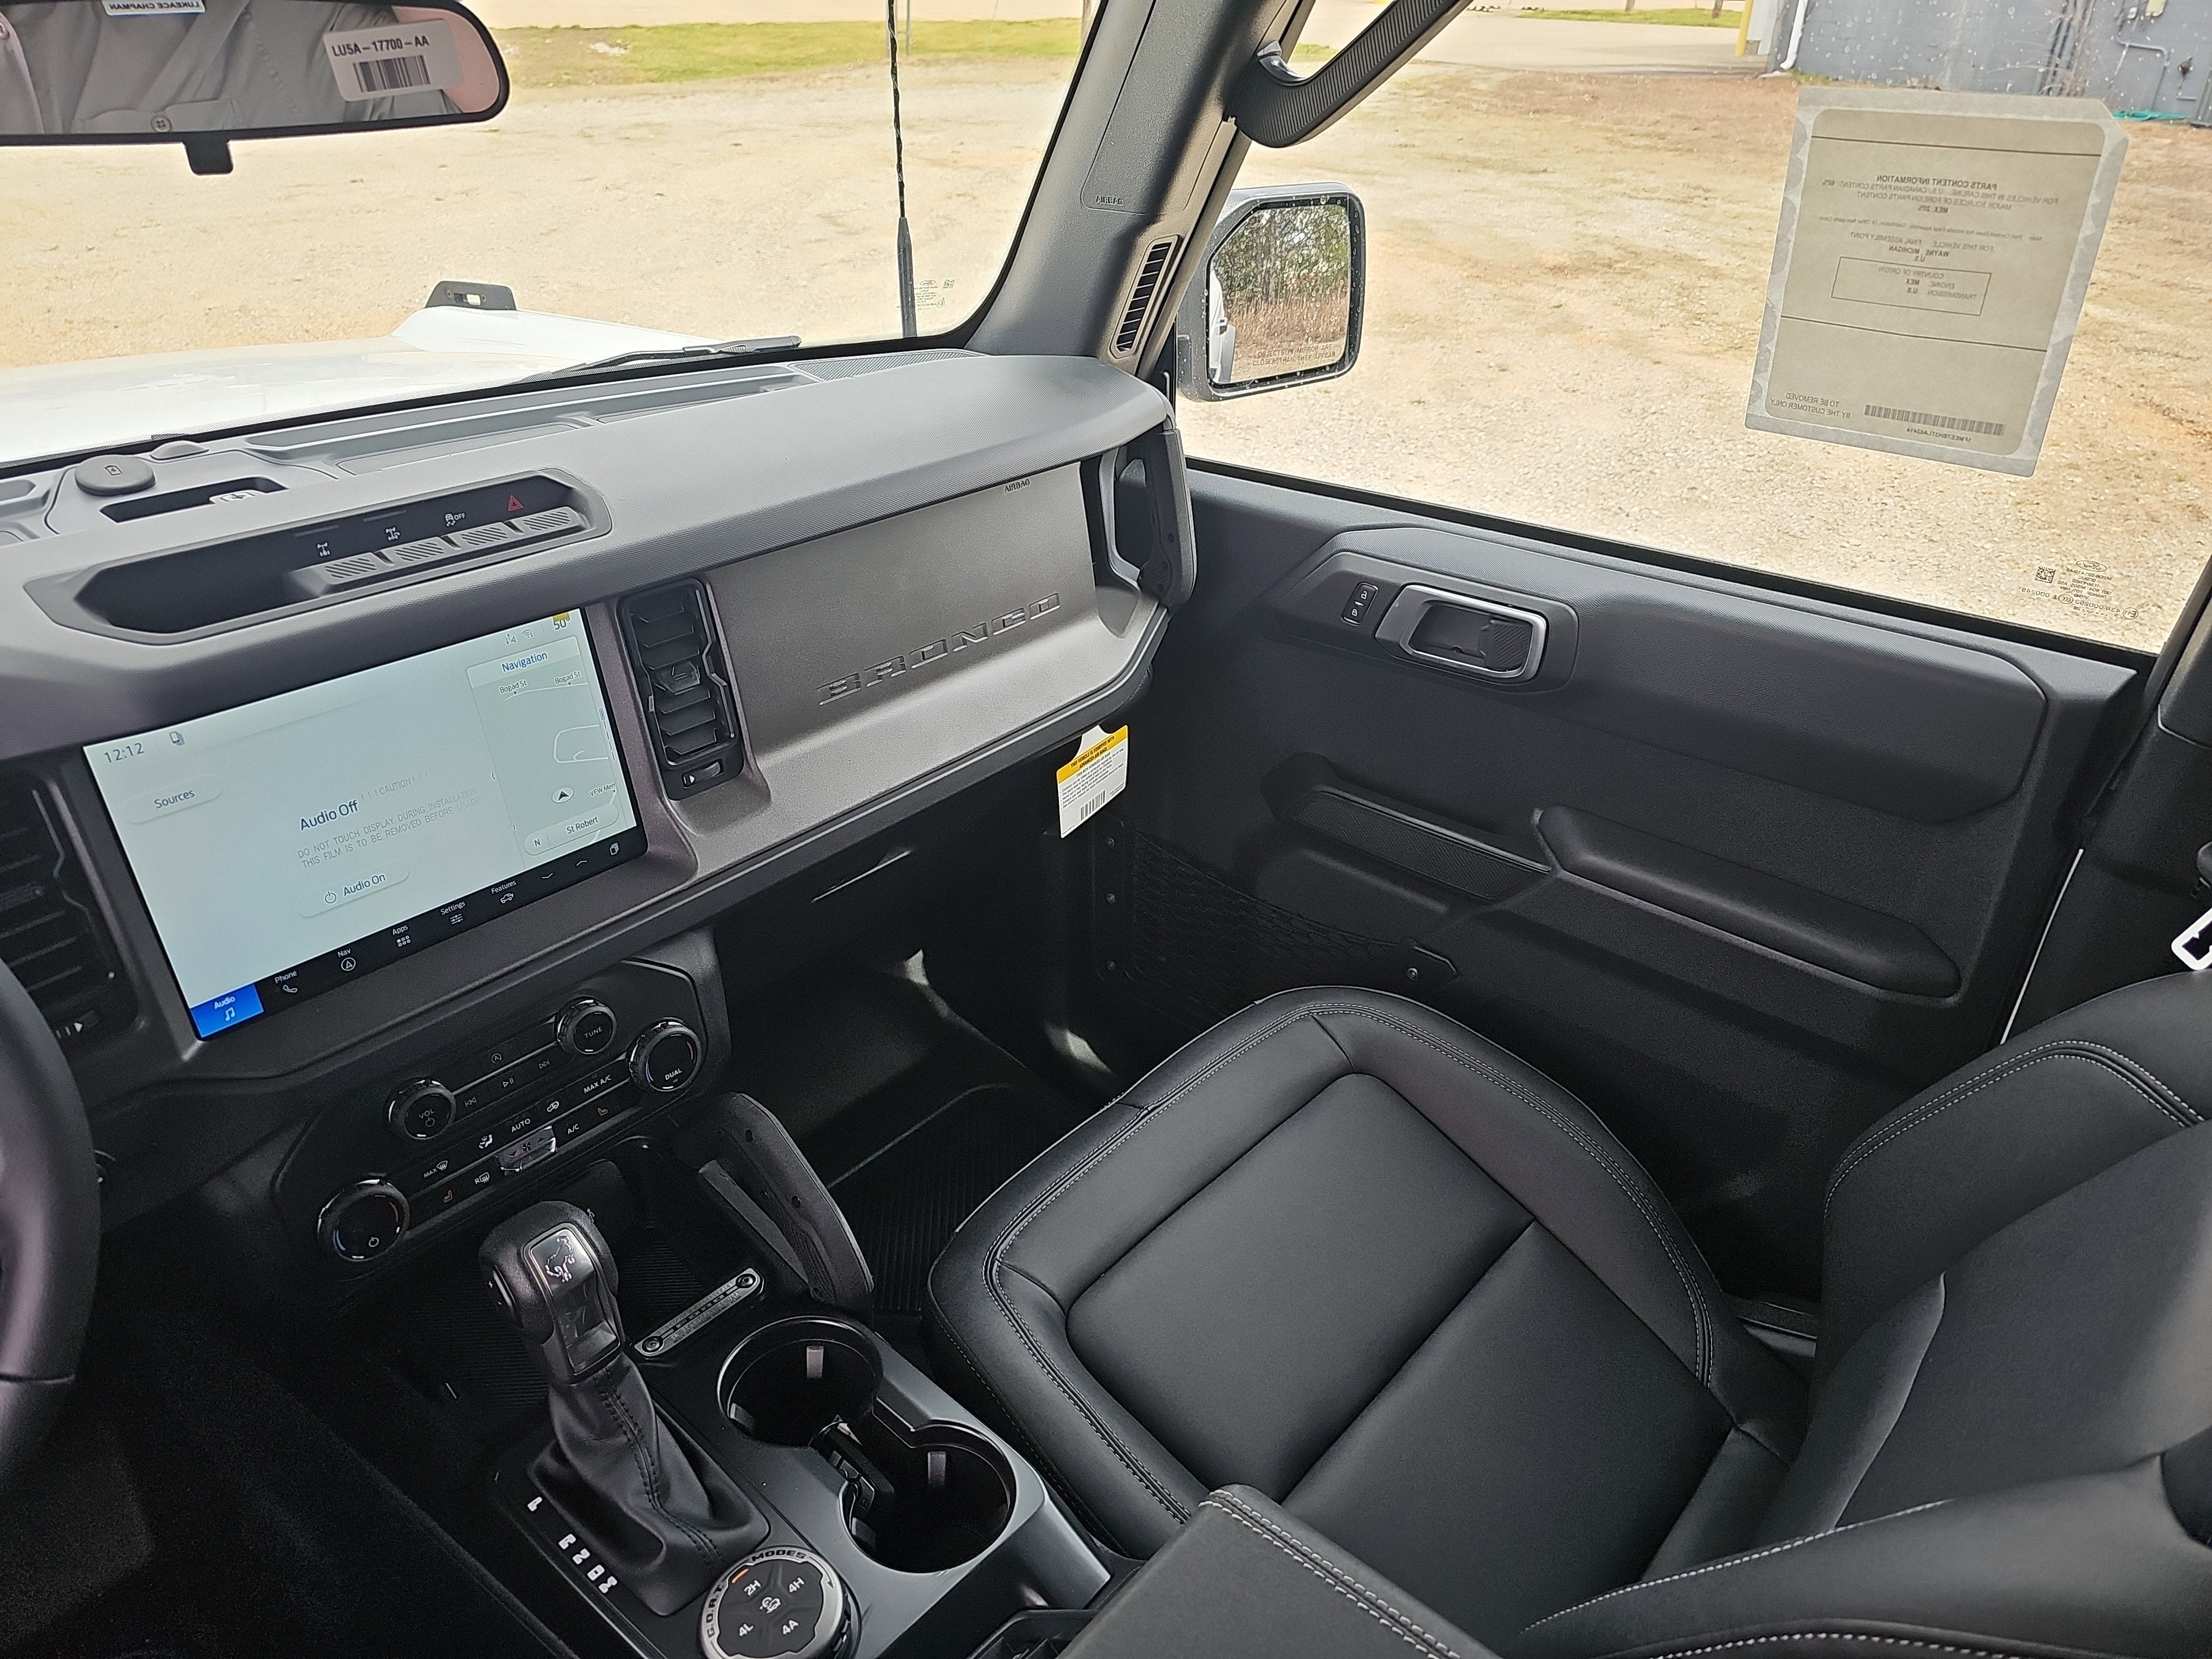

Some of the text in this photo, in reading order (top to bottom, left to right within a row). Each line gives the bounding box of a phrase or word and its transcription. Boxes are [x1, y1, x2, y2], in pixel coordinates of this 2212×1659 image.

[1258, 350, 1284, 358] OBJECTS
[1297, 345, 1319, 353] MIRROR
[1314, 351, 1335, 359] APPEAR
[1005, 479, 1030, 493] AIRBAG
[816, 593, 1060, 705] BRONCO
[502, 652, 548, 672] Navigation
[555, 673, 574, 684] Bogad
[499, 683, 519, 694] Bogad
[104, 743, 144, 763] 12:12
[154, 789, 195, 808] Sources
[589, 787, 603, 796] VFW
[298, 787, 477, 858] DO NOT TOUCH DISPLAY DURING INSTALLATION
[300, 800, 358, 831] Audio Off
[567, 816, 599, 834] St Robert
[301, 857, 320, 868] THIS
[324, 847, 342, 860] FILM
[345, 844, 353, 853] IS
[356, 839, 368, 848] TO
[371, 833, 383, 843] BE
[385, 818, 421, 837] REMOVED
[425, 807, 454, 823] BEFORE
[534, 839, 541, 847] N
[343, 872, 386, 897] Audio On
[491, 880, 517, 895] Features
[440, 900, 466, 916] Settings
[391, 924, 409, 937] Apps
[337, 947, 351, 958] Nav
[274, 970, 298, 984] Phone
[213, 994, 235, 1009] Audio
[584, 1026, 603, 1039] TUNE
[665, 1068, 683, 1081] DUAL
[583, 1075, 613, 1094] MAX A/C
[419, 1108, 435, 1119] VOL
[511, 1118, 531, 1133] AUTO
[568, 1124, 580, 1134] A/C
[423, 1168, 437, 1178] MAX
[528, 1496, 542, 1512] P
[558, 1534, 576, 1549] R
[573, 1548, 590, 1565] N
[751, 1549, 807, 1562] MODES
[587, 1564, 605, 1581] D
[744, 1580, 761, 1596] 2H
[789, 1577, 805, 1593] 4H
[739, 1624, 754, 1636] 4L
[782, 1619, 799, 1635] 4A
